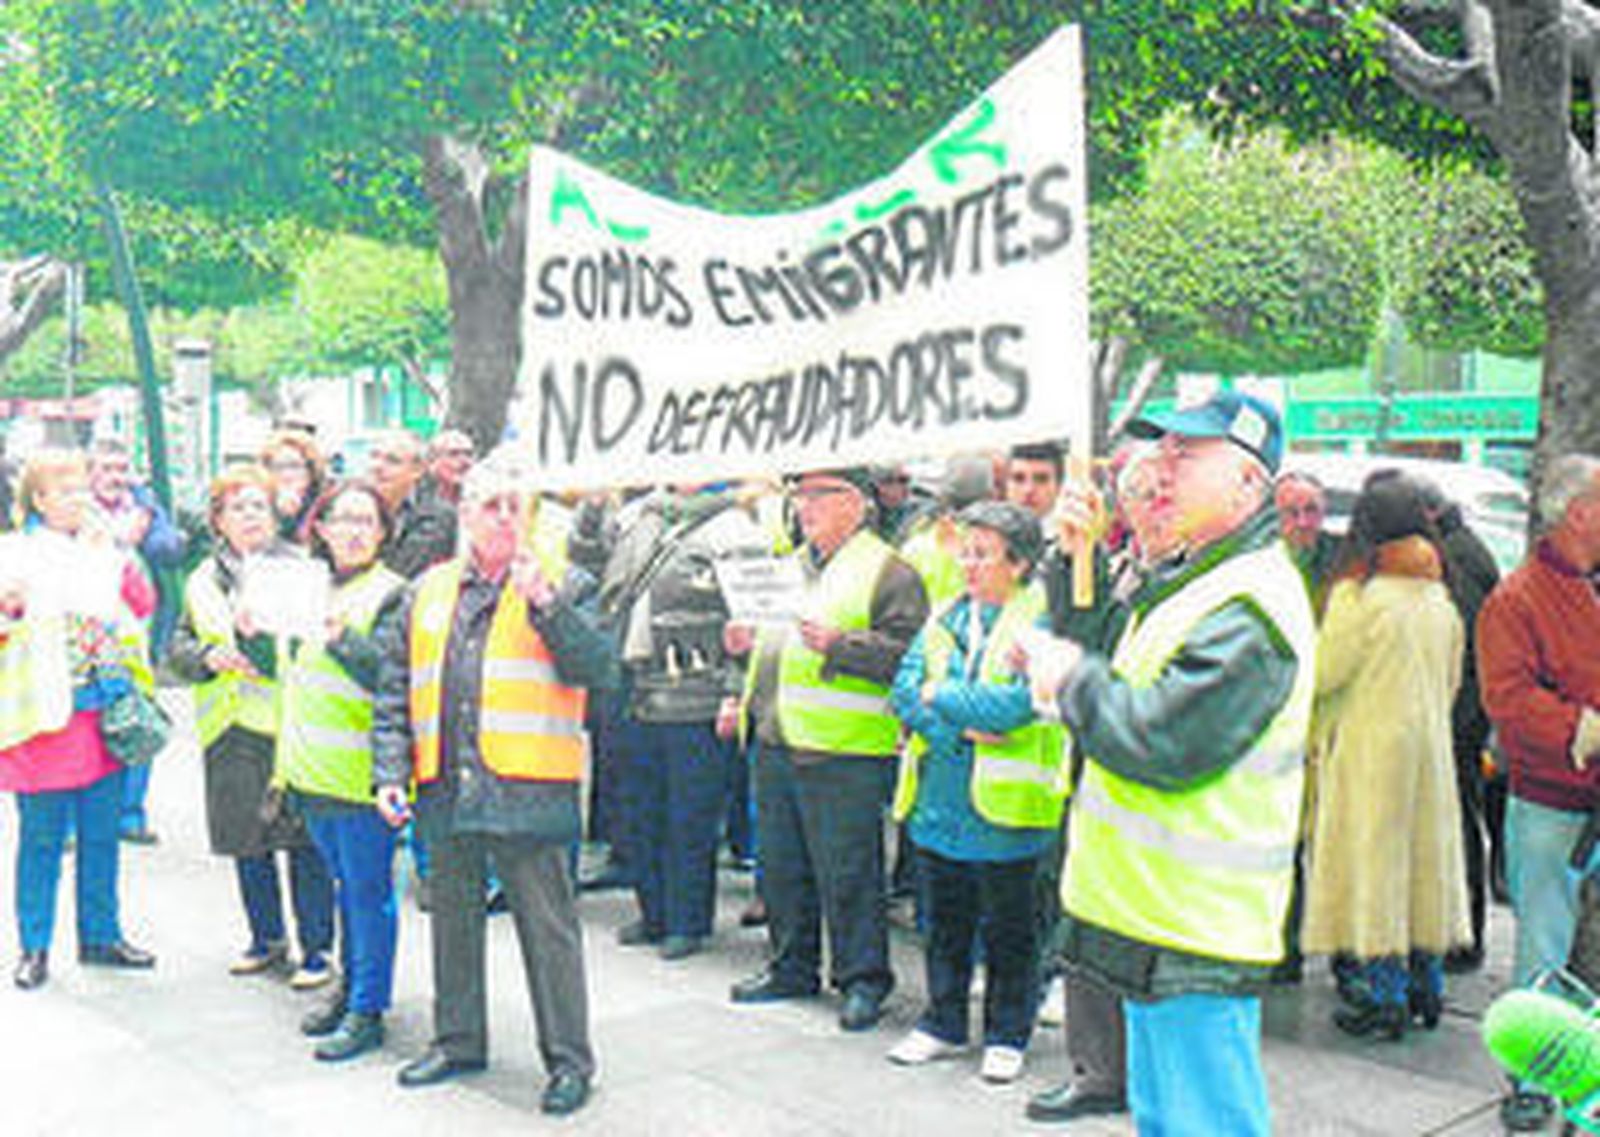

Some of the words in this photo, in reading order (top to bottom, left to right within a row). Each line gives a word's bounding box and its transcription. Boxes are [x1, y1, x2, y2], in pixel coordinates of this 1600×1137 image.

[533, 246, 694, 328] SOMOS
[538, 356, 645, 466] NO
[647, 324, 1030, 454] DEFRAUDADORES
